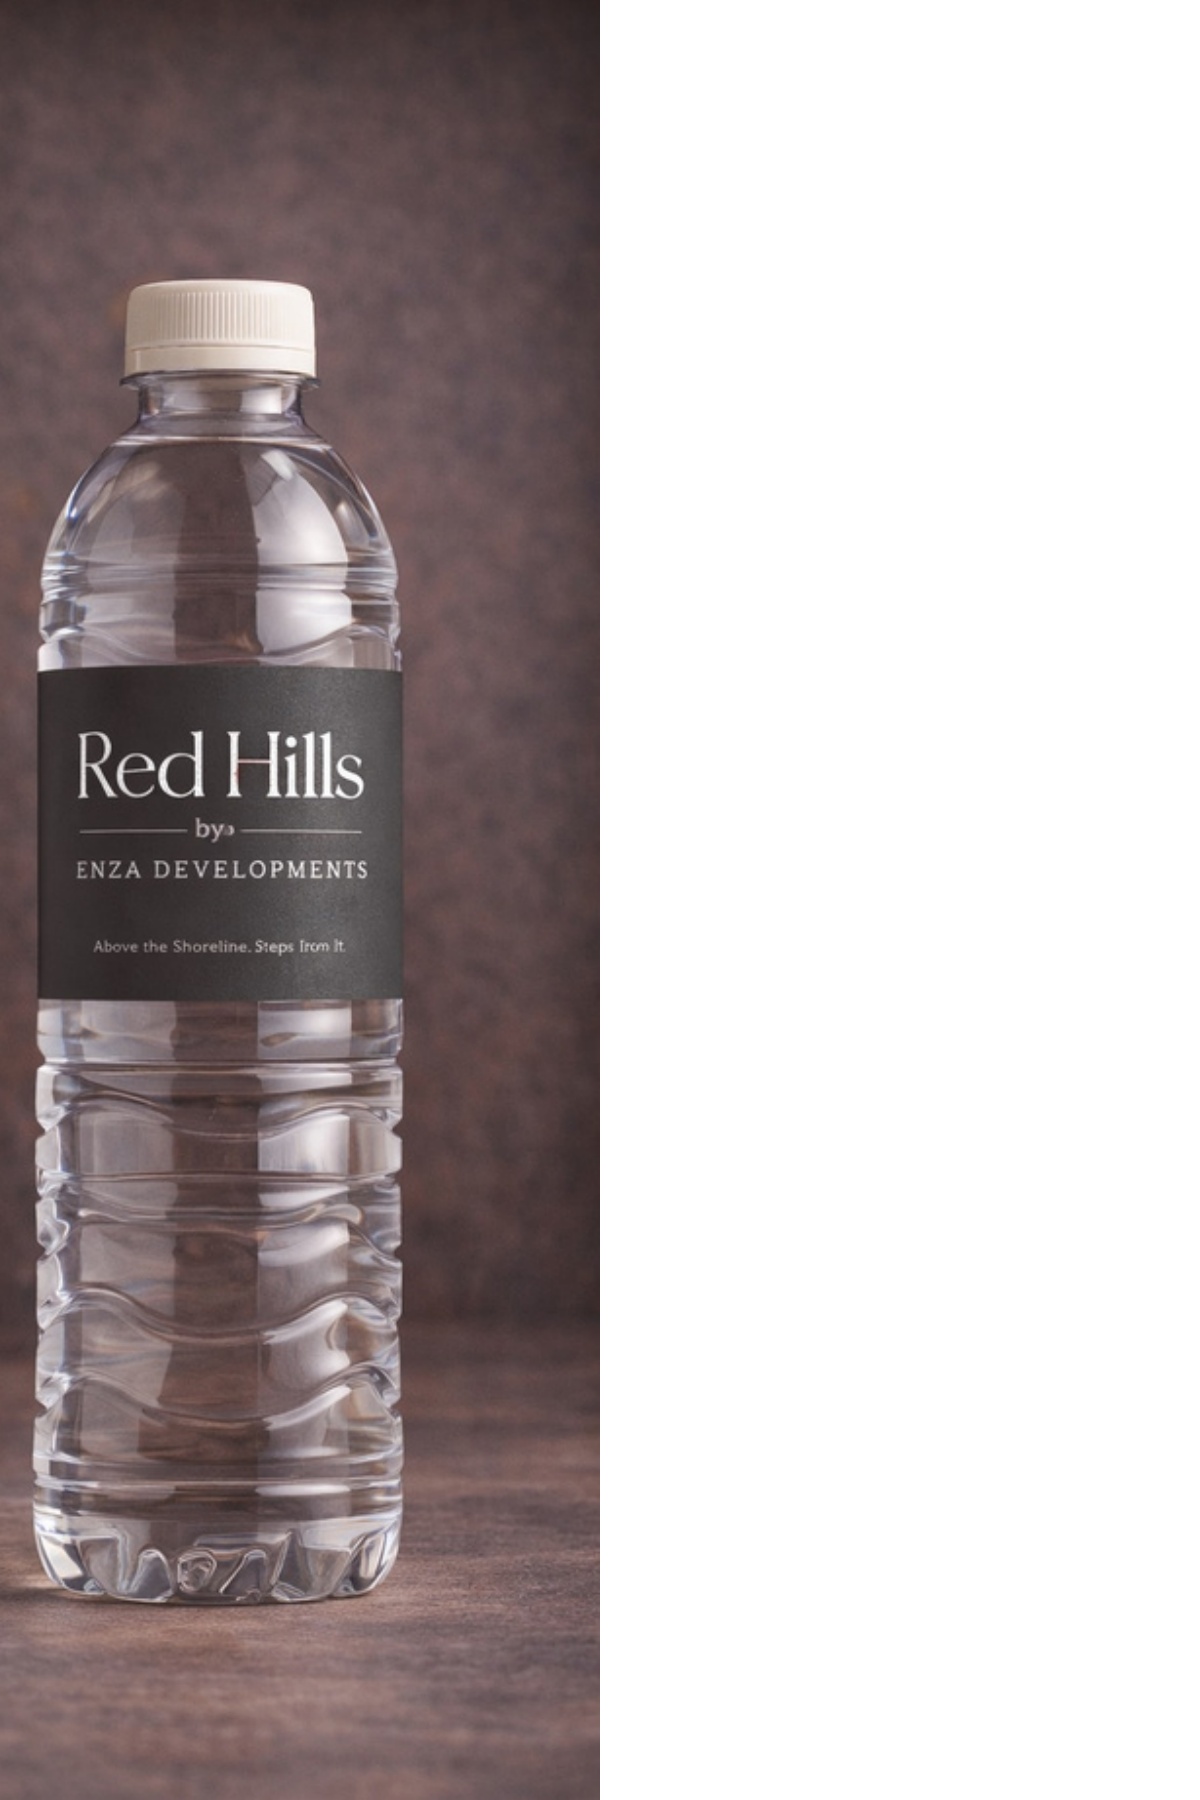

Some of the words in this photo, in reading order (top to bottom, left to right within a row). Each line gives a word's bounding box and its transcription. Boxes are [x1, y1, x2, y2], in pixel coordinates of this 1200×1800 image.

[77, 730, 205, 800] Red
[225, 730, 365, 800] Hills
[76, 860, 142, 880] ENZA
[153, 859, 369, 880] DEVELOPMENTS
[93, 939, 138, 953] Above
[143, 940, 168, 953] the
[172, 939, 252, 953] Shoreline.
[254, 939, 295, 957] Steps
